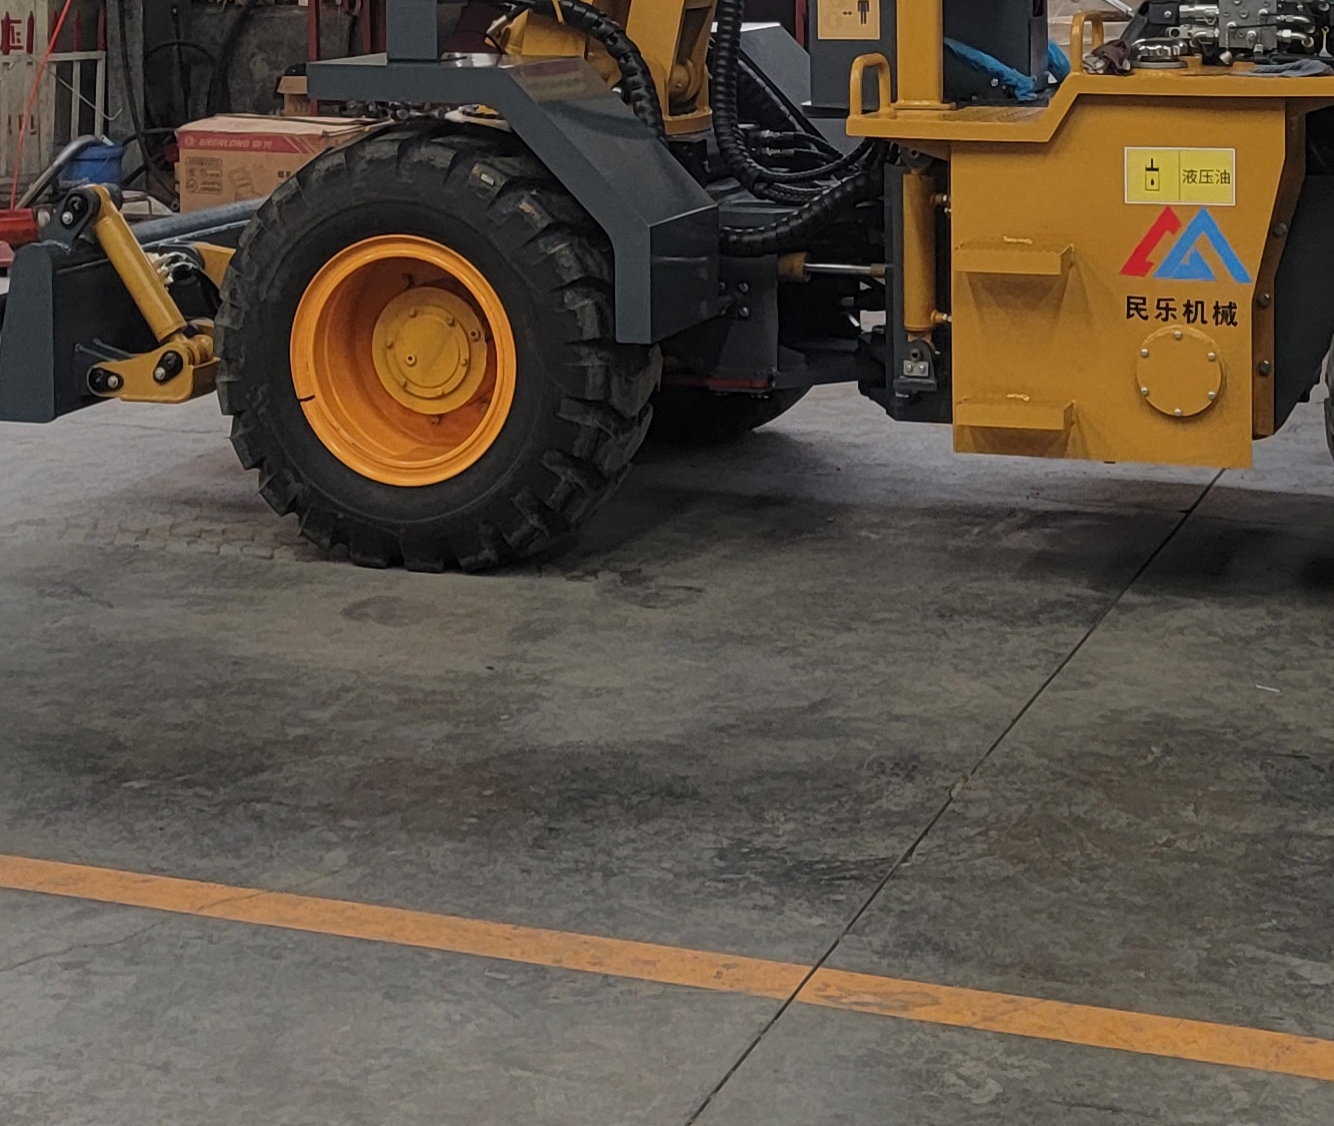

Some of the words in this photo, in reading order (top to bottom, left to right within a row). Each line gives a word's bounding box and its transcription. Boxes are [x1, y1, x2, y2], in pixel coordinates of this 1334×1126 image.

[1182, 168, 1231, 186] 液压油
[1125, 295, 1238, 327] 民乐机械
